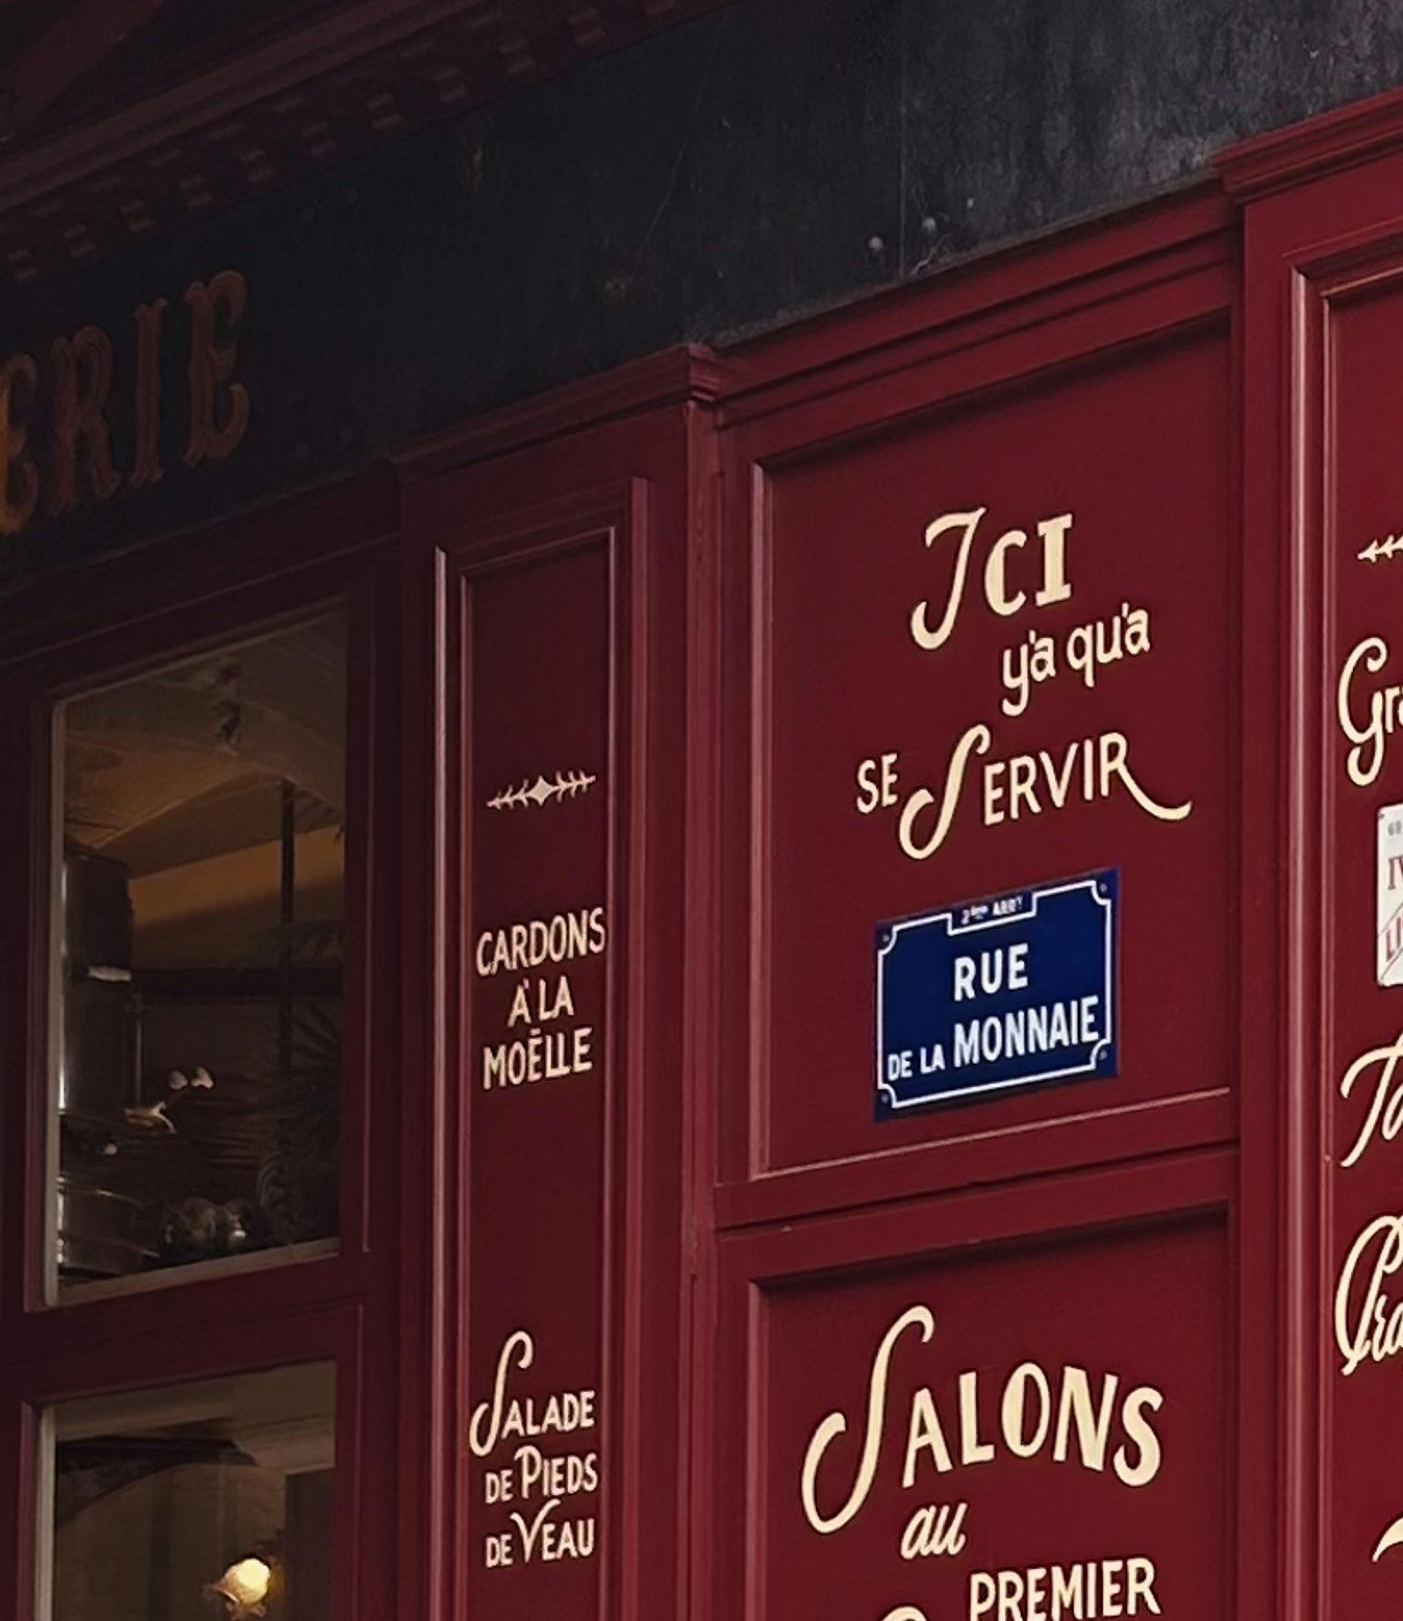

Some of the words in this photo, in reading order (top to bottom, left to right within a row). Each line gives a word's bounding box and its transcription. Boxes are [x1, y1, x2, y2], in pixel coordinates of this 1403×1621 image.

[911, 507, 1073, 649] ICI
[857, 753, 898, 813] SE
[899, 724, 1192, 859] SERVIR
[476, 907, 606, 976] CARDONS
[954, 942, 1029, 1001] RUE
[538, 975, 574, 1021] LA
[483, 1027, 593, 1090] MOËLLE
[888, 1050, 912, 1081] DE
[920, 1043, 945, 1074] LA
[953, 995, 1099, 1068] MONNAIE
[469, 1330, 596, 1457] SALADE
[801, 1304, 1164, 1534] SALONS
[485, 1468, 514, 1504] DE
[514, 1445, 599, 1500] PIEDS
[485, 1533, 514, 1568] DE
[510, 1498, 596, 1563] VEAU
[900, 1501, 968, 1560] au
